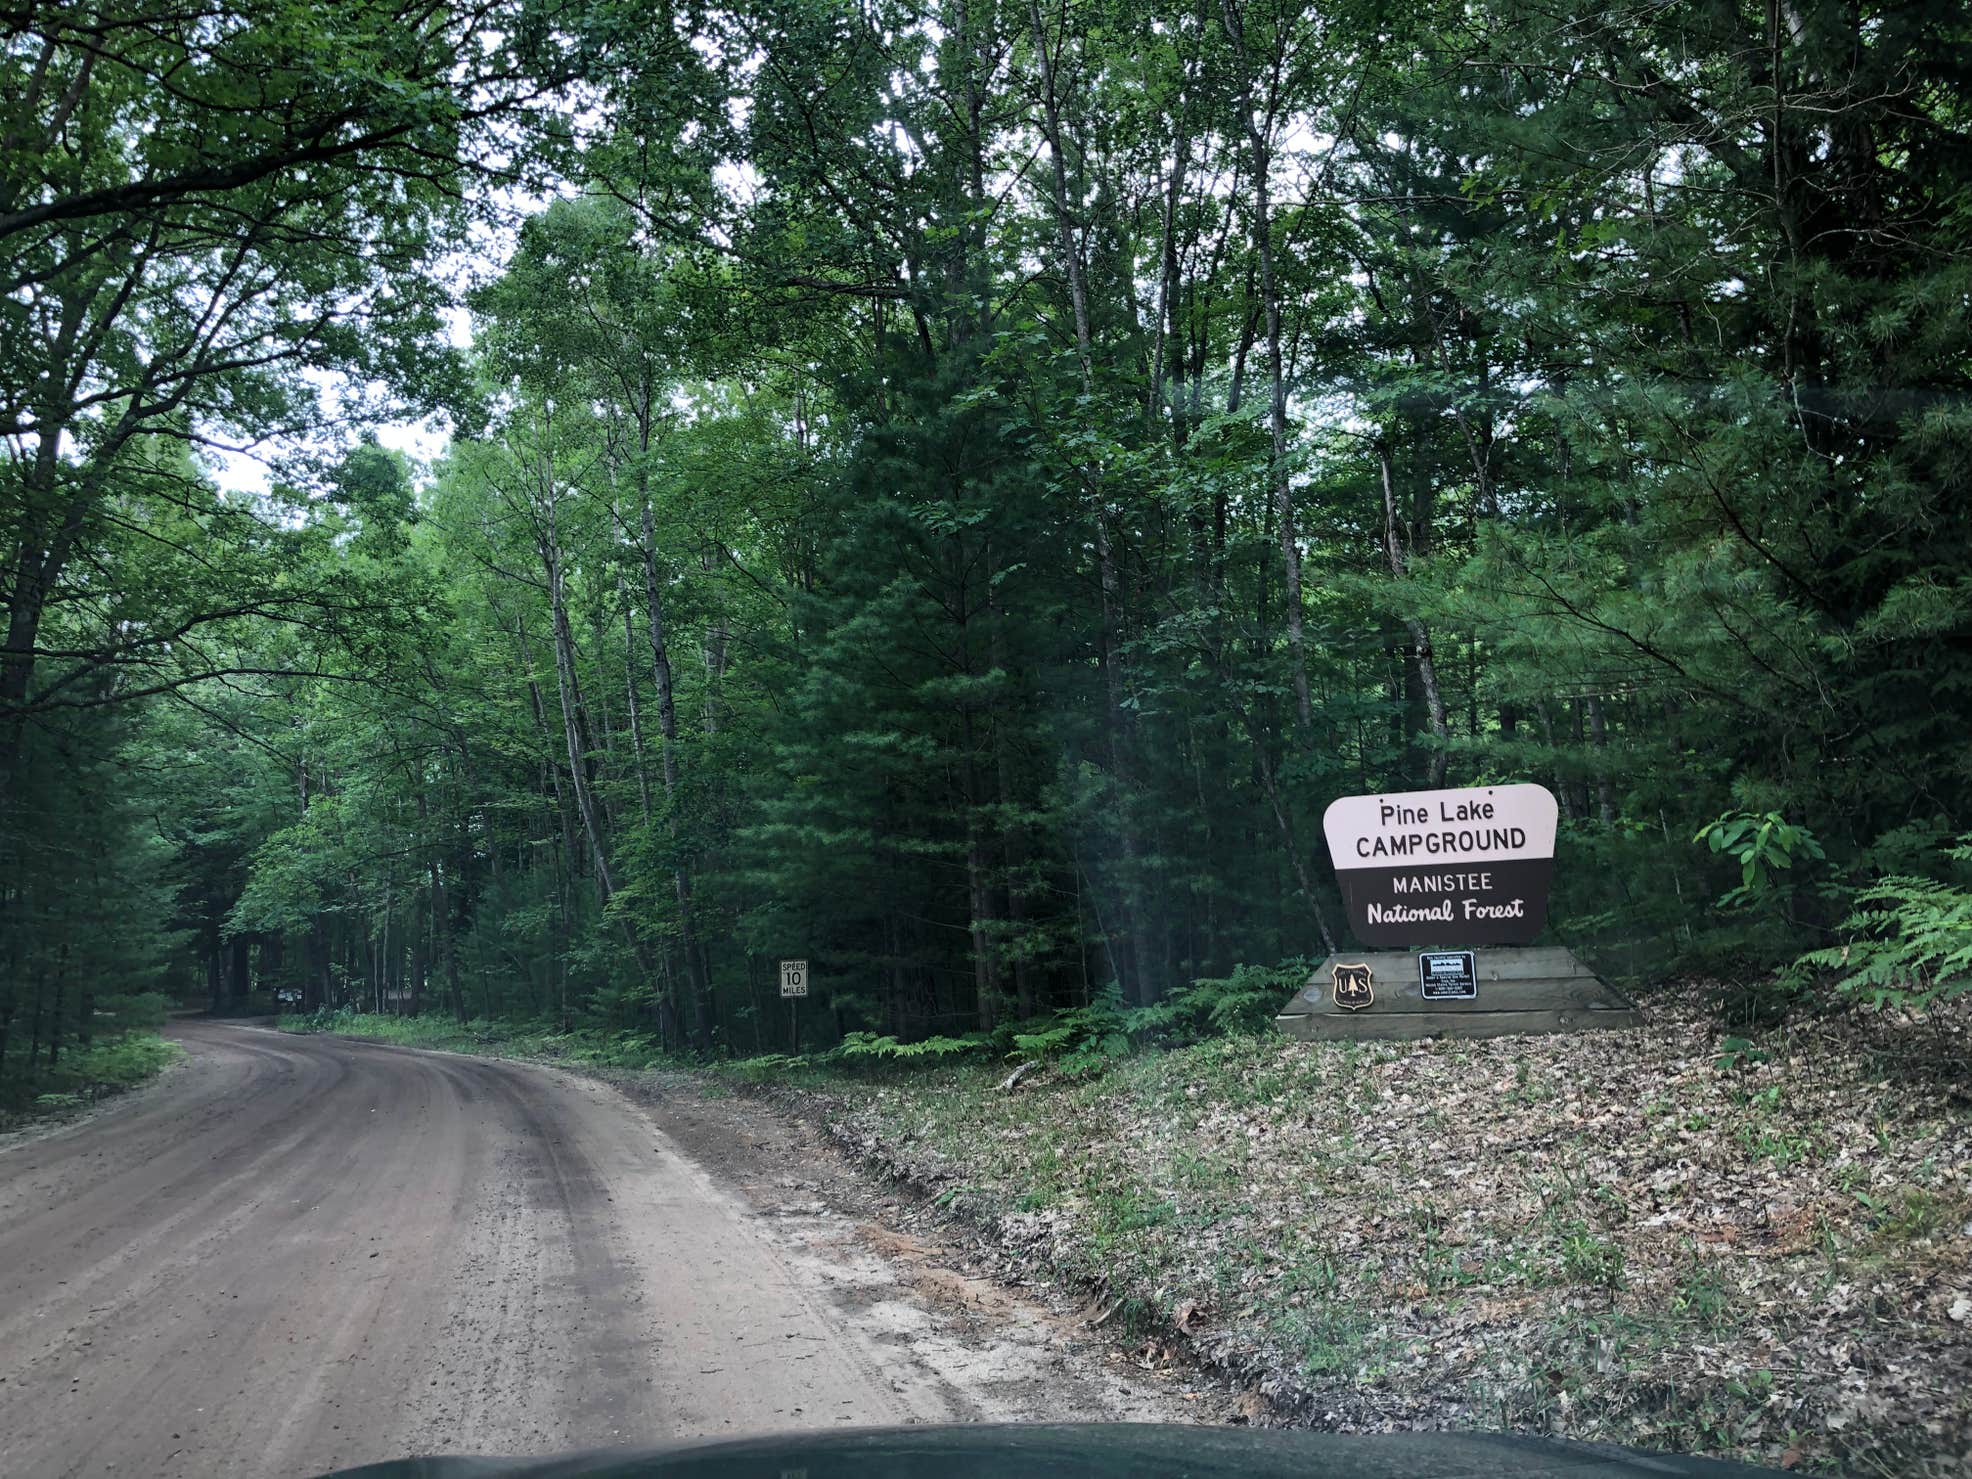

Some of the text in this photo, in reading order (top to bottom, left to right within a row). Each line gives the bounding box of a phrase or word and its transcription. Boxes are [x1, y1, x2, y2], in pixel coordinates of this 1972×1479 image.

[1381, 800, 1494, 826] Pine Lake
[1356, 828, 1526, 858] CAMPGROUND
[1393, 873, 1493, 894] MANISTEE
[1367, 898, 1524, 925] National Forest
[783, 962, 805, 971] SPEED
[787, 972, 801, 985] 10
[783, 986, 805, 994] MILES
